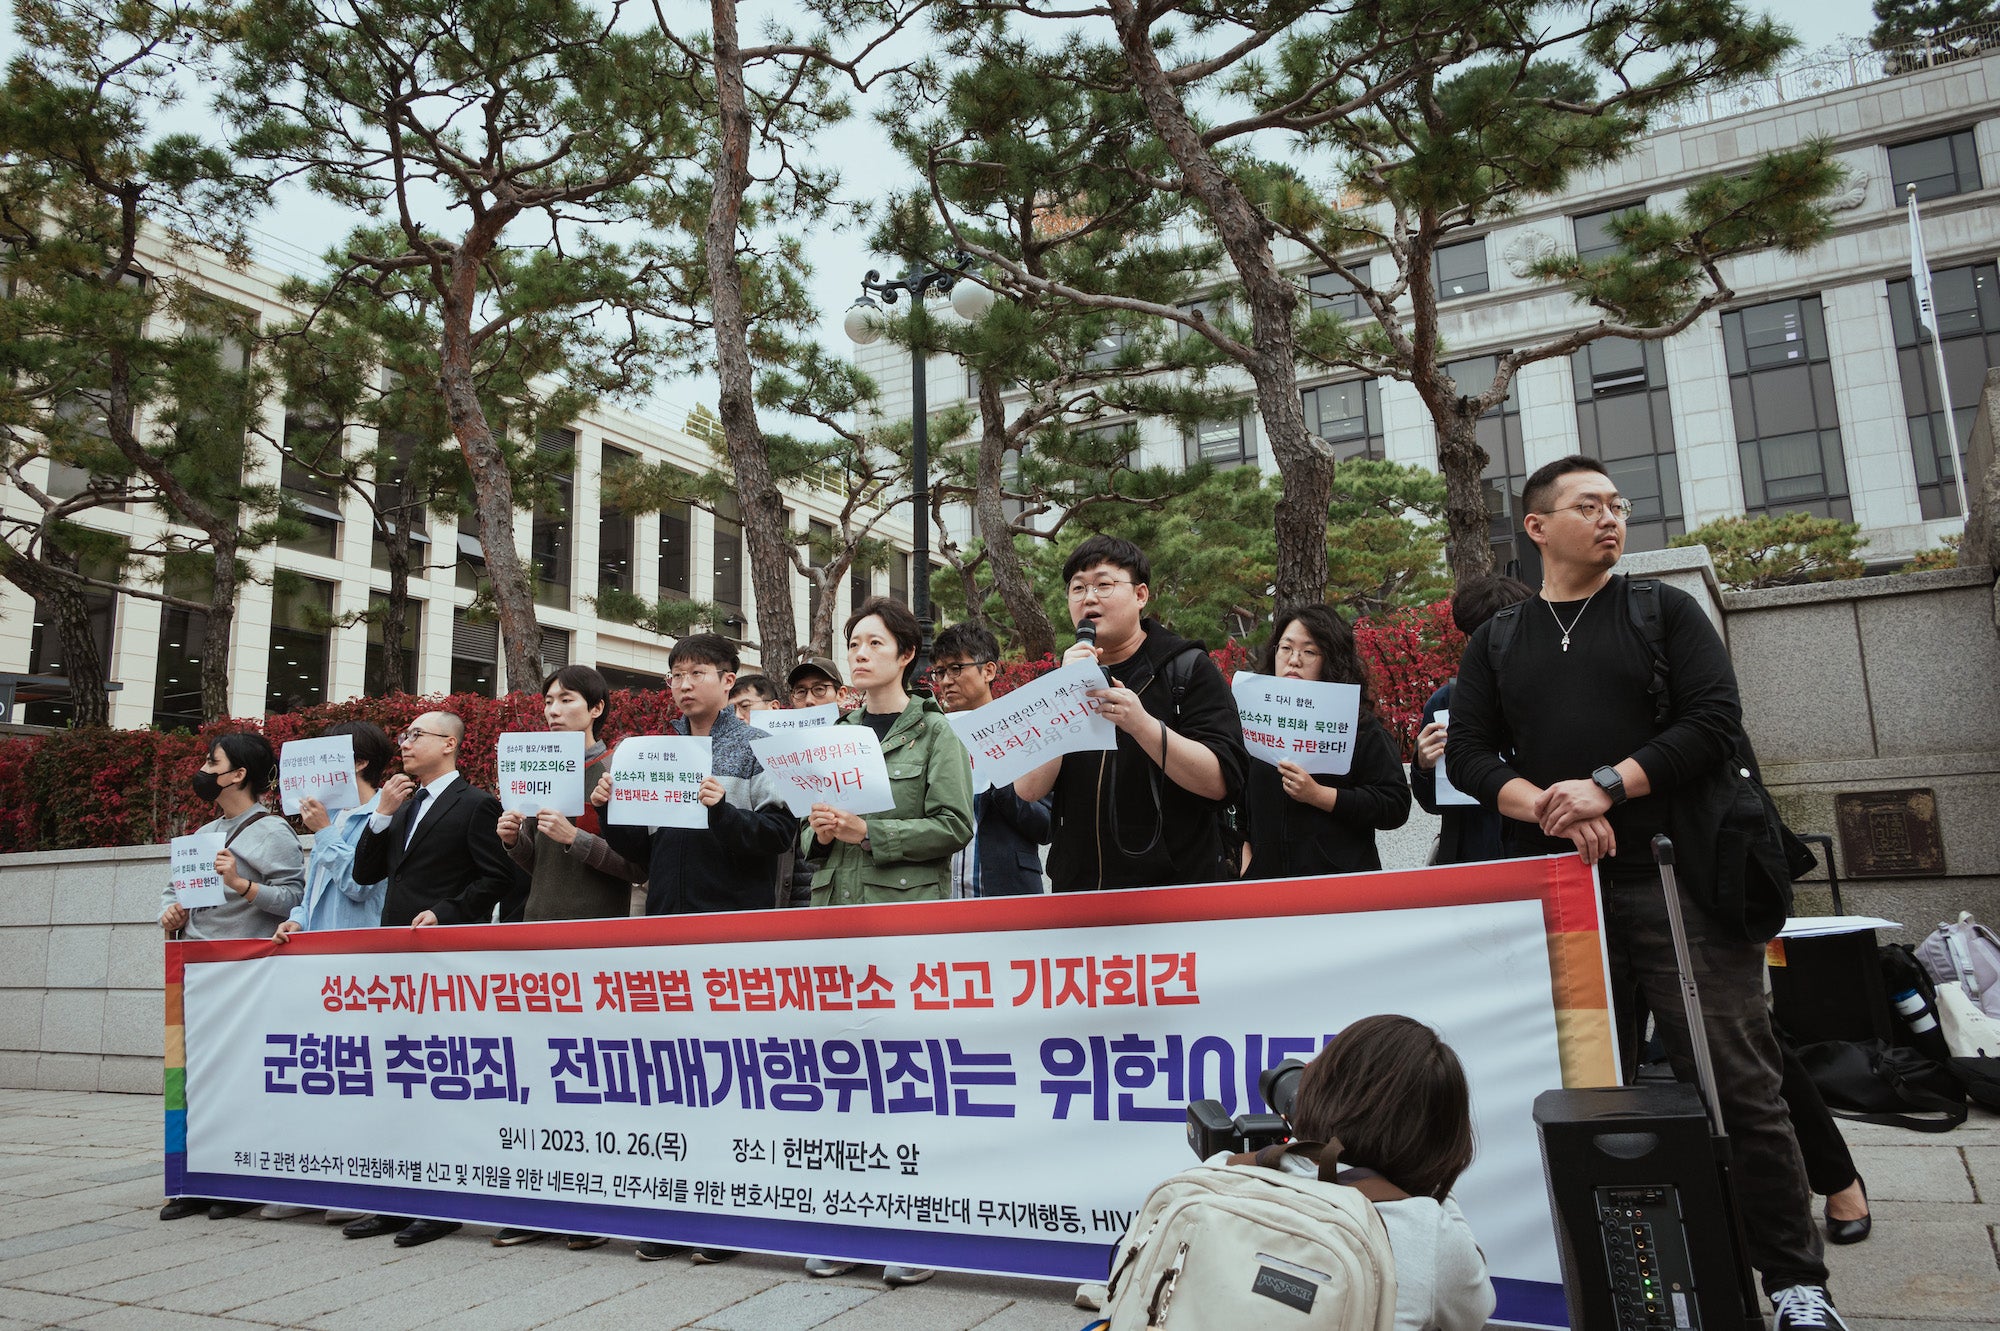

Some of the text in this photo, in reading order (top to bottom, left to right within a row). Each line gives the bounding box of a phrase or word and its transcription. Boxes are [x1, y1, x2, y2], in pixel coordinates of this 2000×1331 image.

[971, 678, 1096, 742] HIV감염인의 섹스는
[1264, 693, 1315, 709] 또 다시 합헌,
[768, 719, 795, 729] 성소수자
[1239, 709, 1348, 734] 성소수자 범죄화 묵인한
[984, 726, 1042, 760] 범죄가
[1241, 726, 1347, 754] 헌법재판소 규탄한다!
[519, 759, 577, 773] 제92조의6은
[647, 752, 660, 761] 다시
[767, 742, 872, 770] 전파매개행위죄는
[310, 771, 349, 788] 아니다
[511, 780, 552, 795] 위헌이다!
[614, 771, 704, 784] 성소수자 범죄화 묵인한
[791, 767, 864, 794] 위헌이다
[614, 788, 659, 802] 헌법재판소
[189, 876, 220, 888] 규탄한다!
[321, 952, 1200, 1015] 성소수자/HIV감염인 처벌법 헌법재판소 선고 기자회견
[264, 1032, 374, 1097] 군형법
[384, 1034, 530, 1105] 추행죄,
[548, 1035, 1016, 1119] 전파매개행위죄는
[499, 1127, 687, 1162] 일시 2023. 10. 26.(목)
[732, 1137, 920, 1176] 장소 헌법재판소 앞
[234, 1151, 251, 1168] 주최
[259, 1151, 271, 1170] 군
[273, 1152, 295, 1172] 관련
[299, 1153, 344, 1176] 성소수자
[426, 1161, 451, 1183] 신고
[455, 1163, 467, 1186] 및
[472, 1164, 512, 1190] 지원을
[515, 1168, 543, 1192] 위한
[547, 1169, 607, 1197] 네트워크,
[613, 1174, 689, 1204] 민주사회를
[693, 1180, 726, 1206] 위한
[731, 1182, 816, 1214] 변호사모임,
[823, 1188, 971, 1225] 성소수자차별반대
[977, 1198, 1086, 1235] 무지개행동,
[1092, 1208, 1139, 1234] HIV
